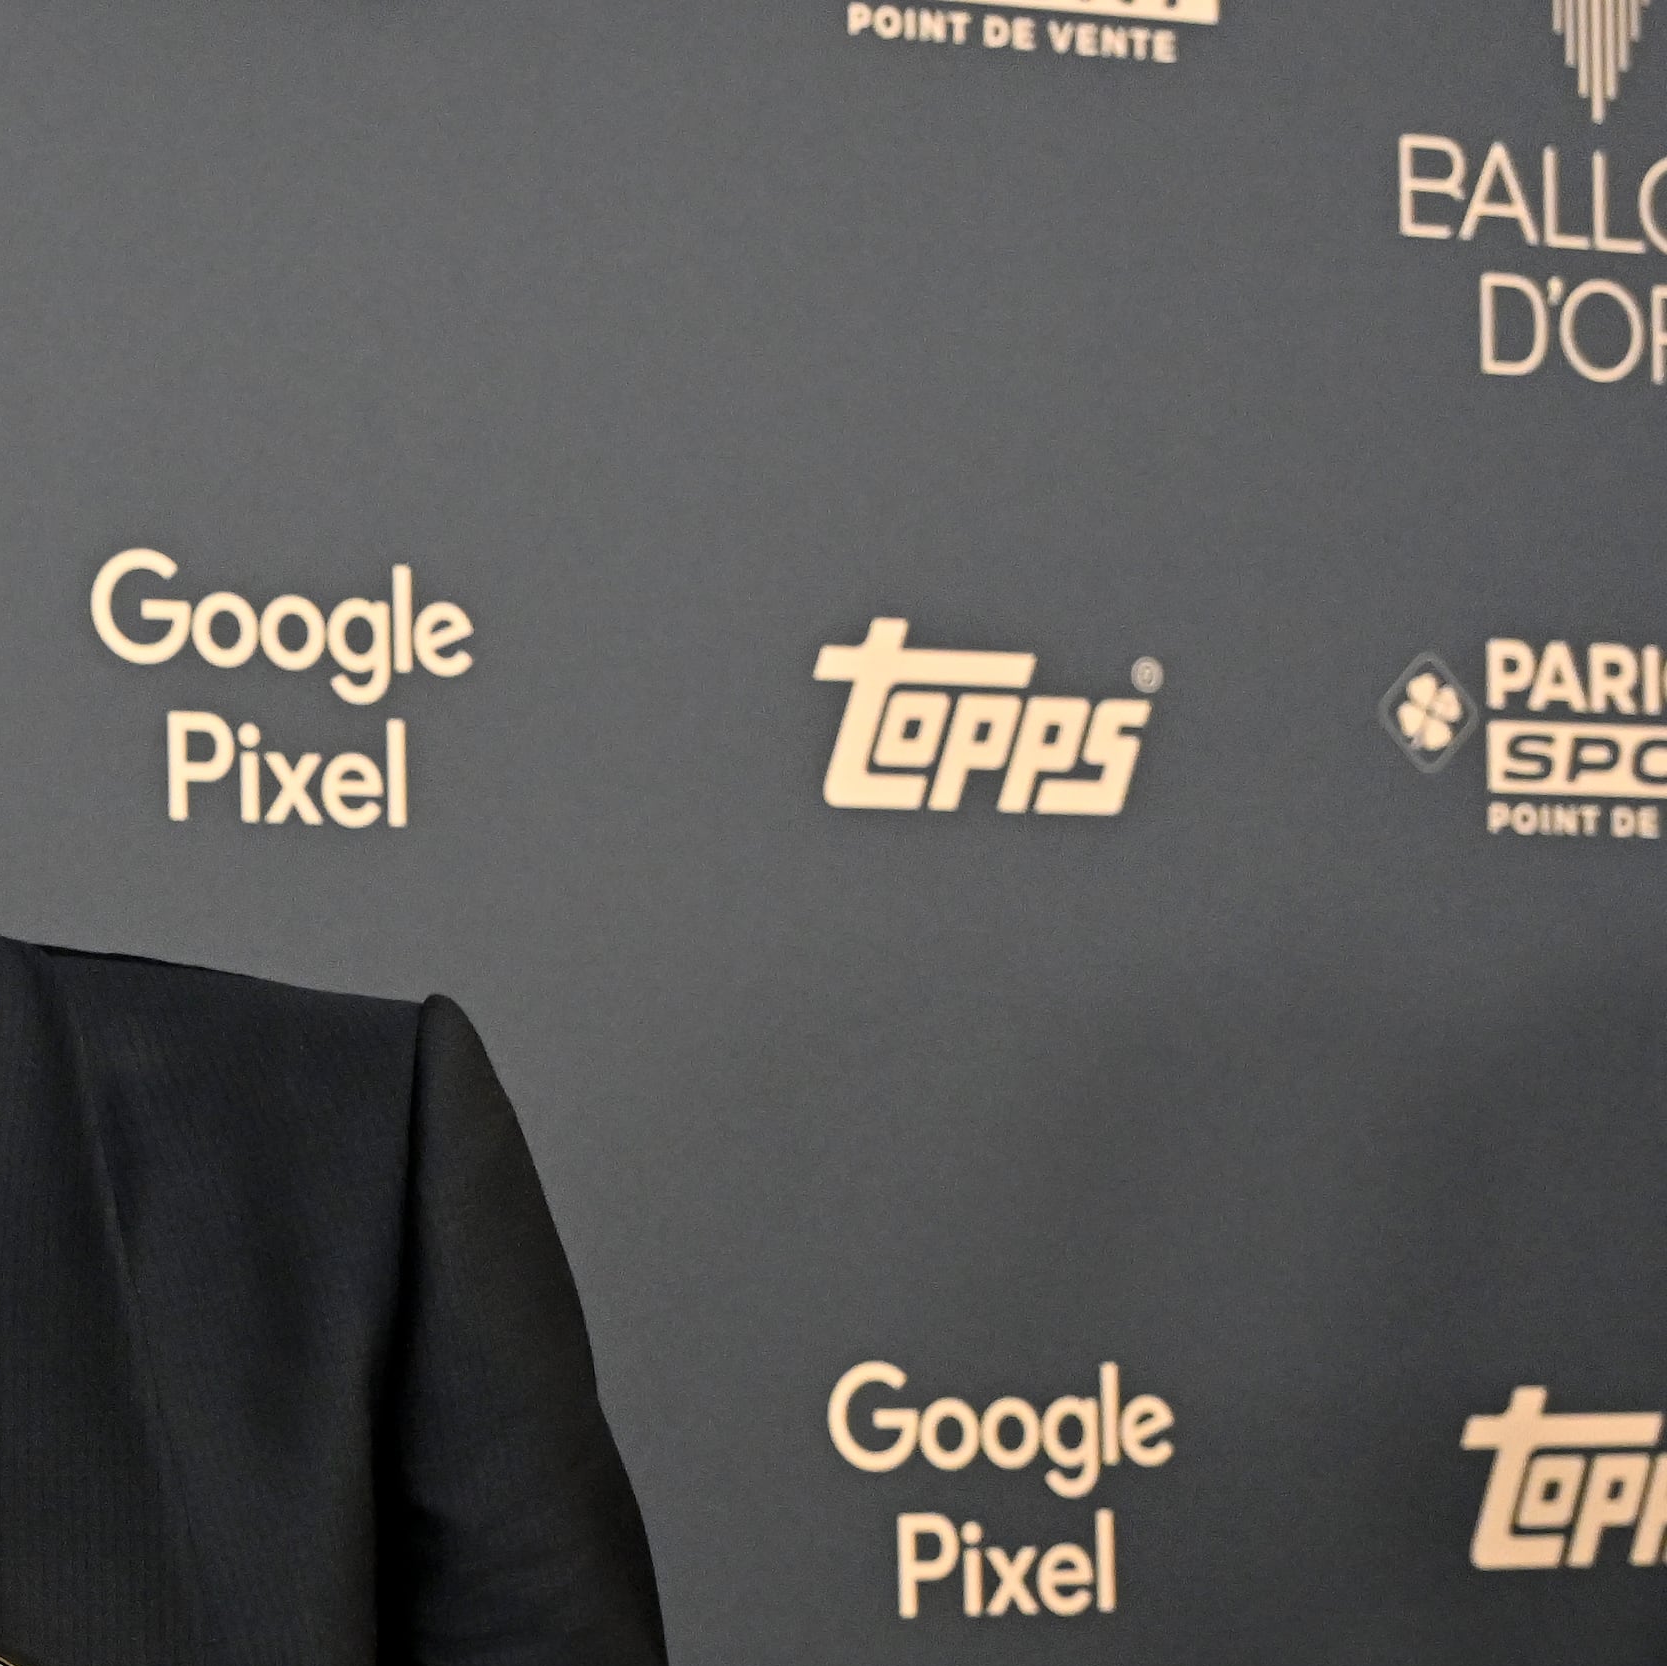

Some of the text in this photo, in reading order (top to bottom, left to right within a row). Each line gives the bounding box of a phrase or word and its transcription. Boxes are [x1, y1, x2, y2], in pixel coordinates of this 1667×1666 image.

[846, 1, 1179, 64] POINT DE VENTE
[1398, 134, 1667, 256] BALL
[1479, 270, 1667, 384] D'O
[90, 547, 475, 705] Google
[1485, 637, 1667, 717] PARI
[167, 710, 409, 829] Pixel
[1503, 733, 1667, 785] SPO
[1486, 801, 1662, 840] POINT DE
[827, 1360, 1176, 1498] Google
[897, 1508, 1117, 1619] Pixel
